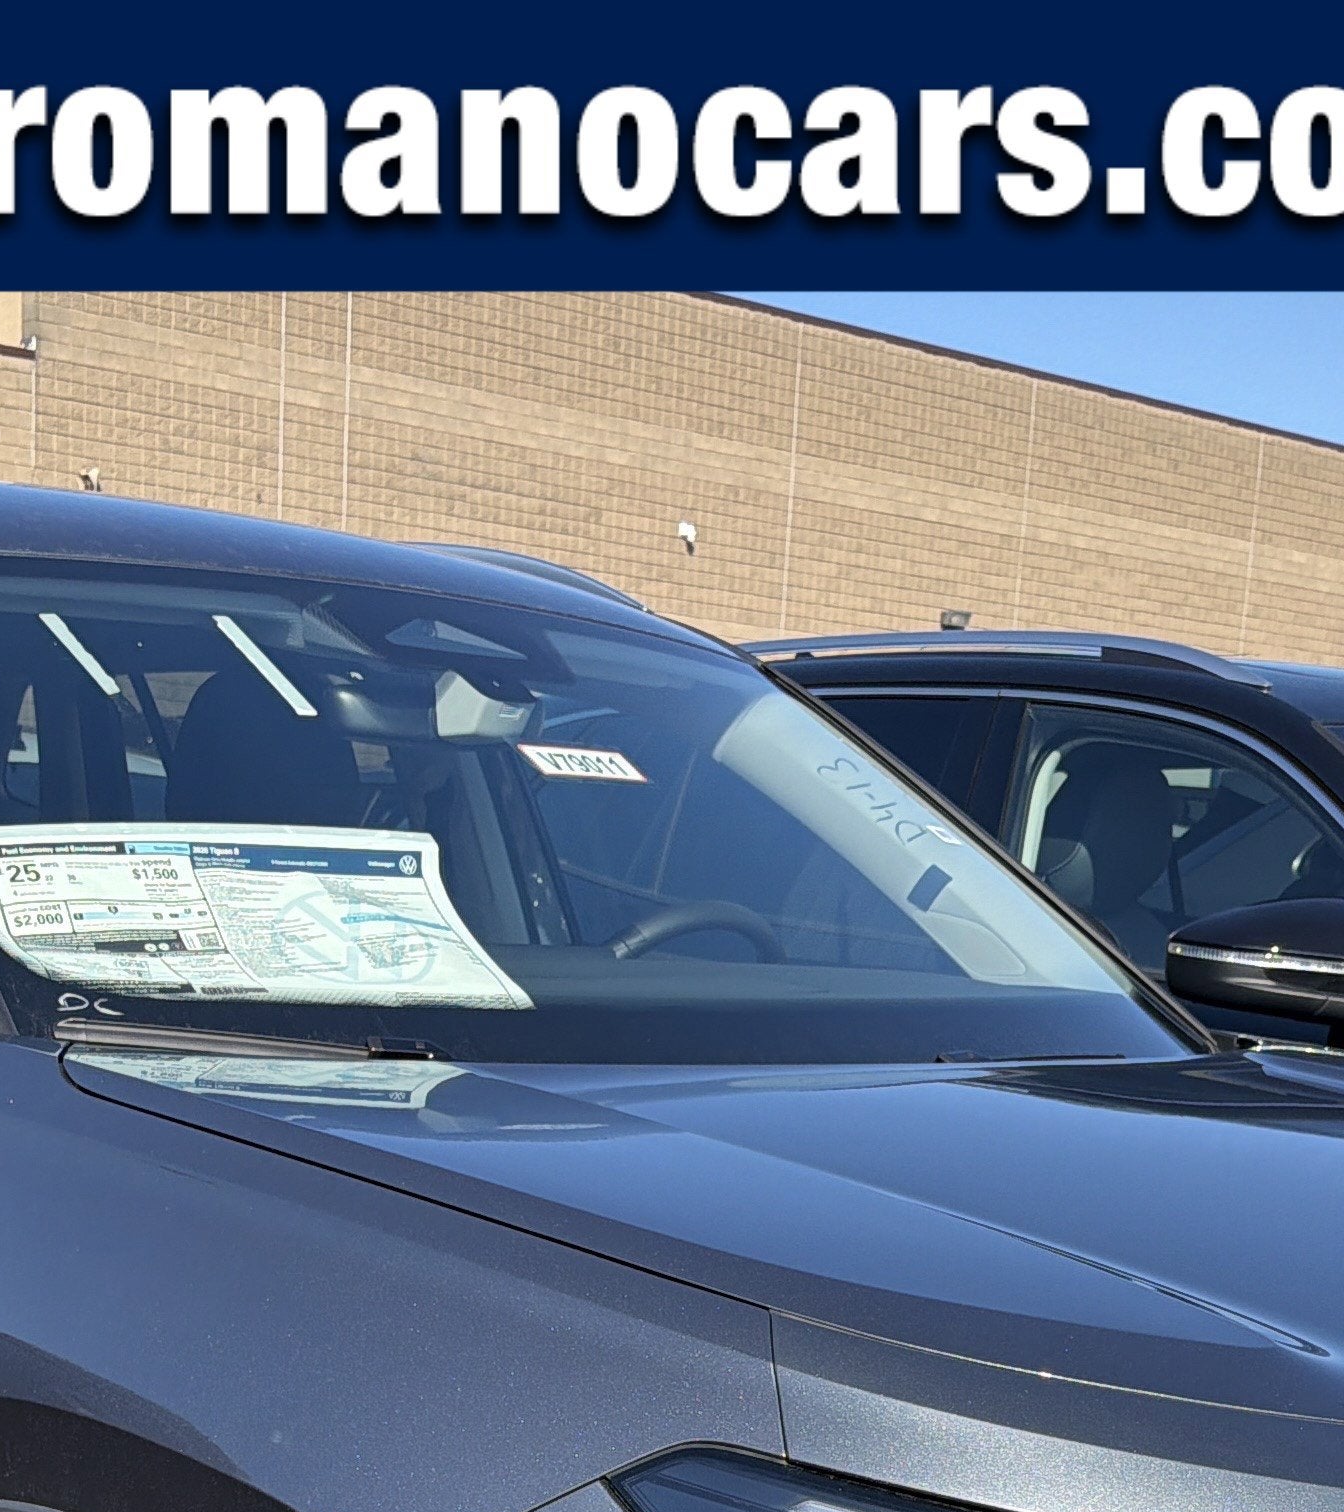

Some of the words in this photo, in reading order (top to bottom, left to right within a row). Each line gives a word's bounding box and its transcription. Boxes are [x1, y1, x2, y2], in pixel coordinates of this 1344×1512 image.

[535, 751, 629, 777] V79011
[6, 863, 41, 883] 25
[132, 867, 179, 881] $1,500
[13, 912, 64, 928] $2,000
